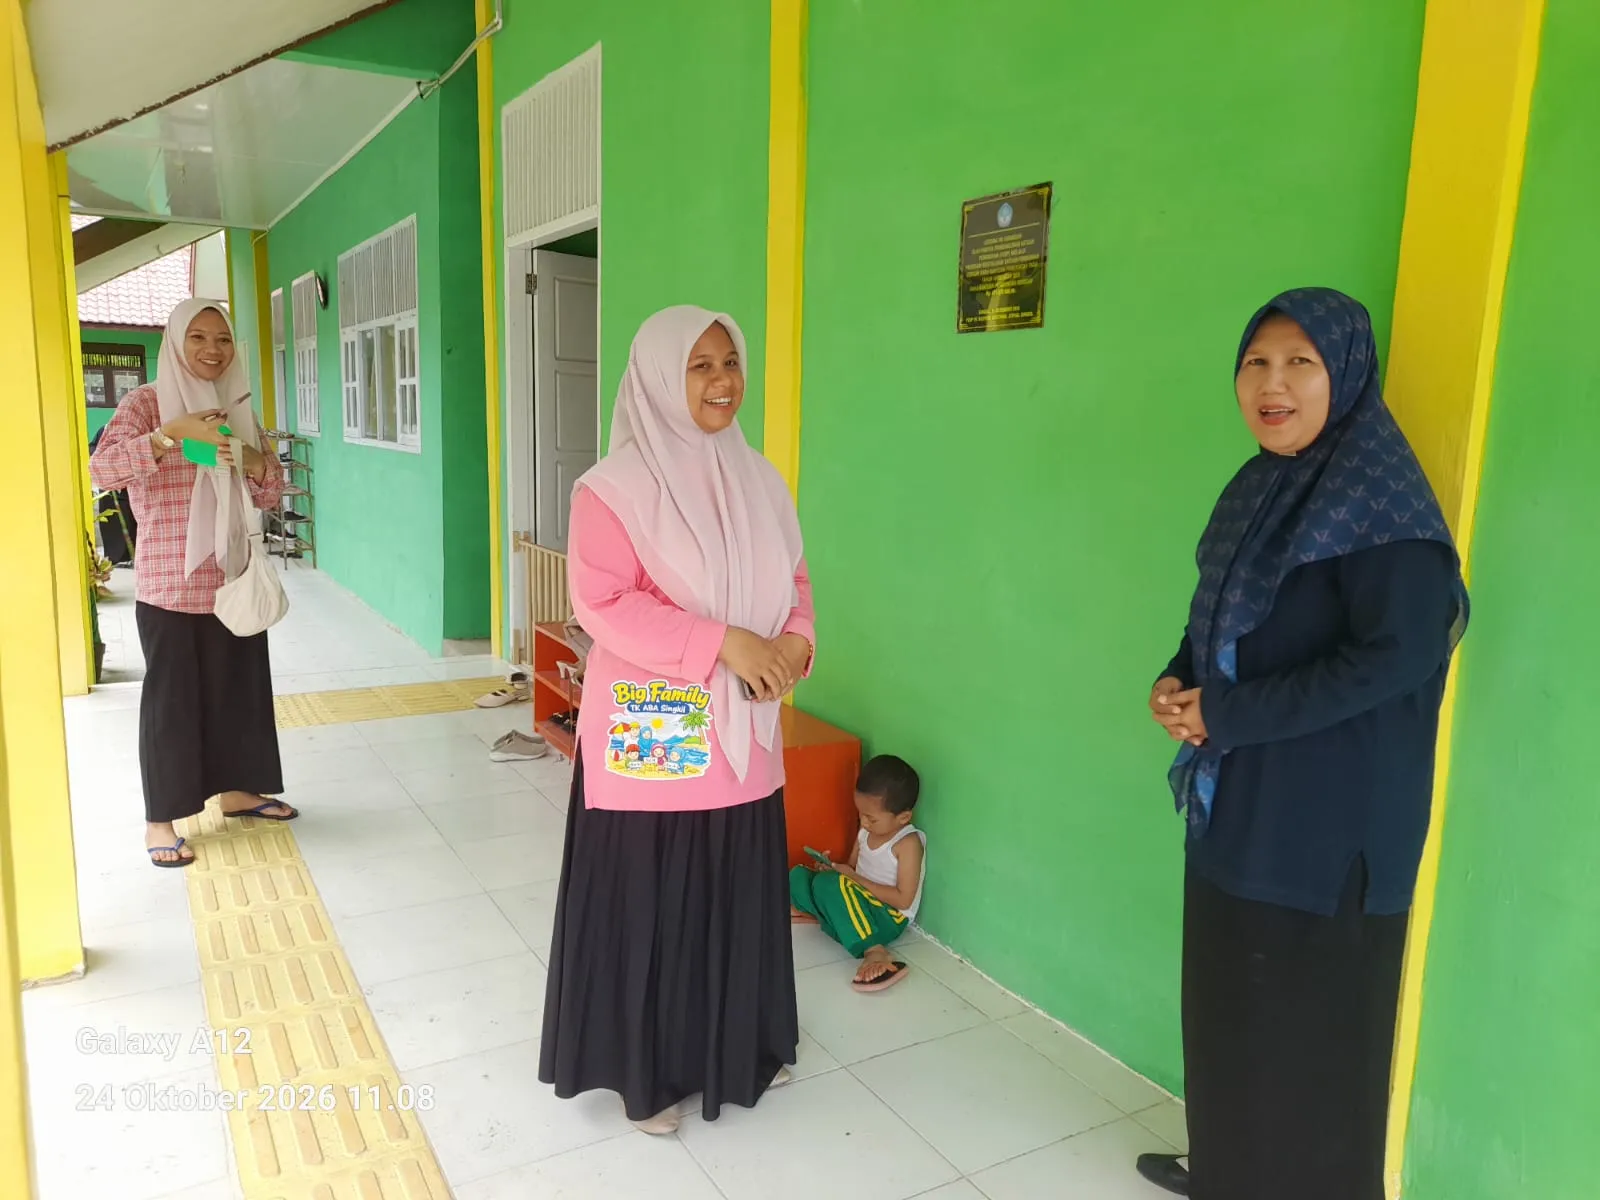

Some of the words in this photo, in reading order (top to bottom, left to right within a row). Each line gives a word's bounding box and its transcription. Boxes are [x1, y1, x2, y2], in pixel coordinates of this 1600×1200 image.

[613, 682, 647, 704] Big
[649, 681, 711, 709] Family
[661, 704, 686, 713] Singkil
